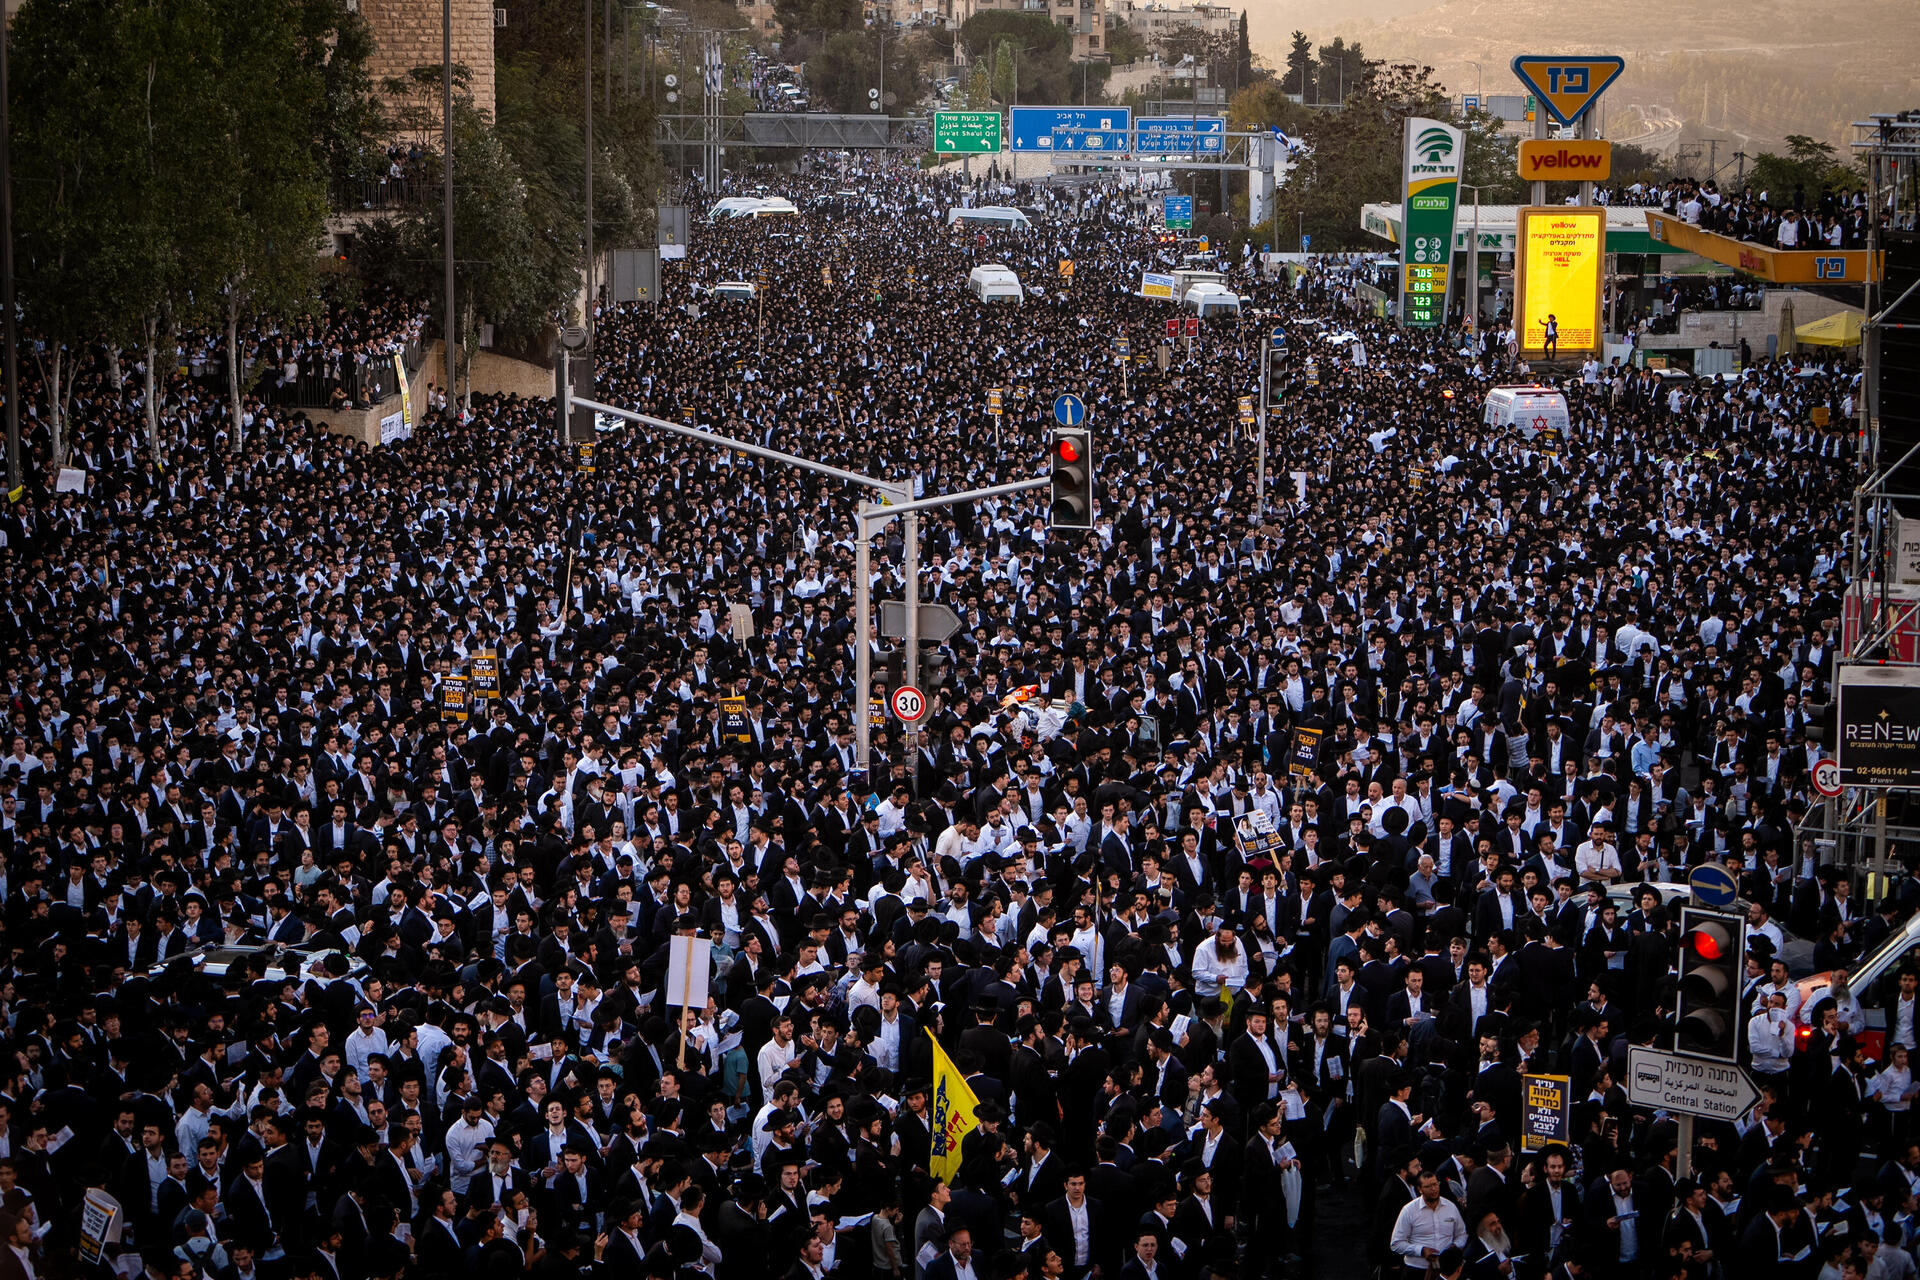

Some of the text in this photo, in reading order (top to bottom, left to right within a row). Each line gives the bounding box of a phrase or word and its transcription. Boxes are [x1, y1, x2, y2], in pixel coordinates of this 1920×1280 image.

[1547, 67, 1589, 94] פז
[1530, 150, 1602, 171] yellow
[1412, 164, 1437, 173] אלון
[1416, 199, 1446, 207] אלונית
[1551, 221, 1577, 229] yellow
[1816, 257, 1846, 278] פז
[1415, 268, 1433, 278] 7.05
[1414, 282, 1432, 292] 8.69
[1413, 296, 1431, 306] 7.23
[1412, 311, 1431, 320] 7.48
[899, 697, 920, 711] 30
[1297, 751, 1314, 759] לצבא
[1856, 767, 1908, 776] 02-9661144
[1819, 770, 1839, 787] 30
[1664, 1060, 1739, 1083] תחנה מרכזית
[1535, 1079, 1555, 1089] עדיף
[1664, 1078, 1738, 1097] المحطة المركزية
[1533, 1087, 1557, 1098] למות
[1530, 1096, 1560, 1108] כחרדי
[1664, 1092, 1737, 1115] Central Station
[1537, 1107, 1551, 1115] ולא
[1528, 1113, 1560, 1124] להתגייס
[1533, 1121, 1555, 1131] לצבא
